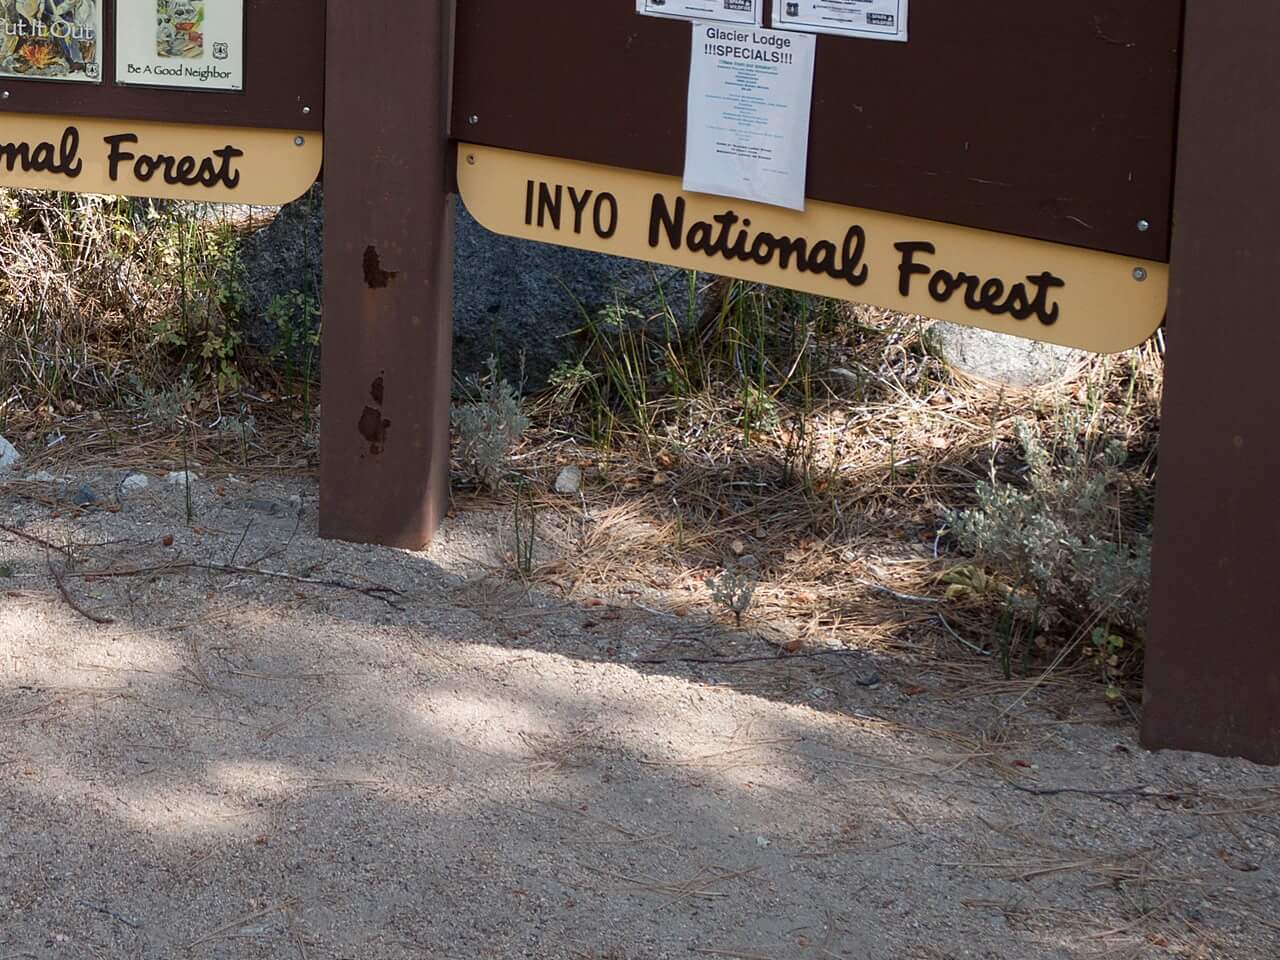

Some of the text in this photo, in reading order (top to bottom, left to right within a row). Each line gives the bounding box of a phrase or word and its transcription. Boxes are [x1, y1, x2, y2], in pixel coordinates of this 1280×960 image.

[32, 17, 47, 37] It
[50, 19, 94, 40] Out
[706, 27, 791, 49] Glacier Lodge
[703, 43, 793, 64] !!!SPECIALS!!!
[127, 63, 232, 81] Be A Good Neighbor
[103, 133, 244, 189] Forest
[524, 179, 1065, 326] INYO National Forest
